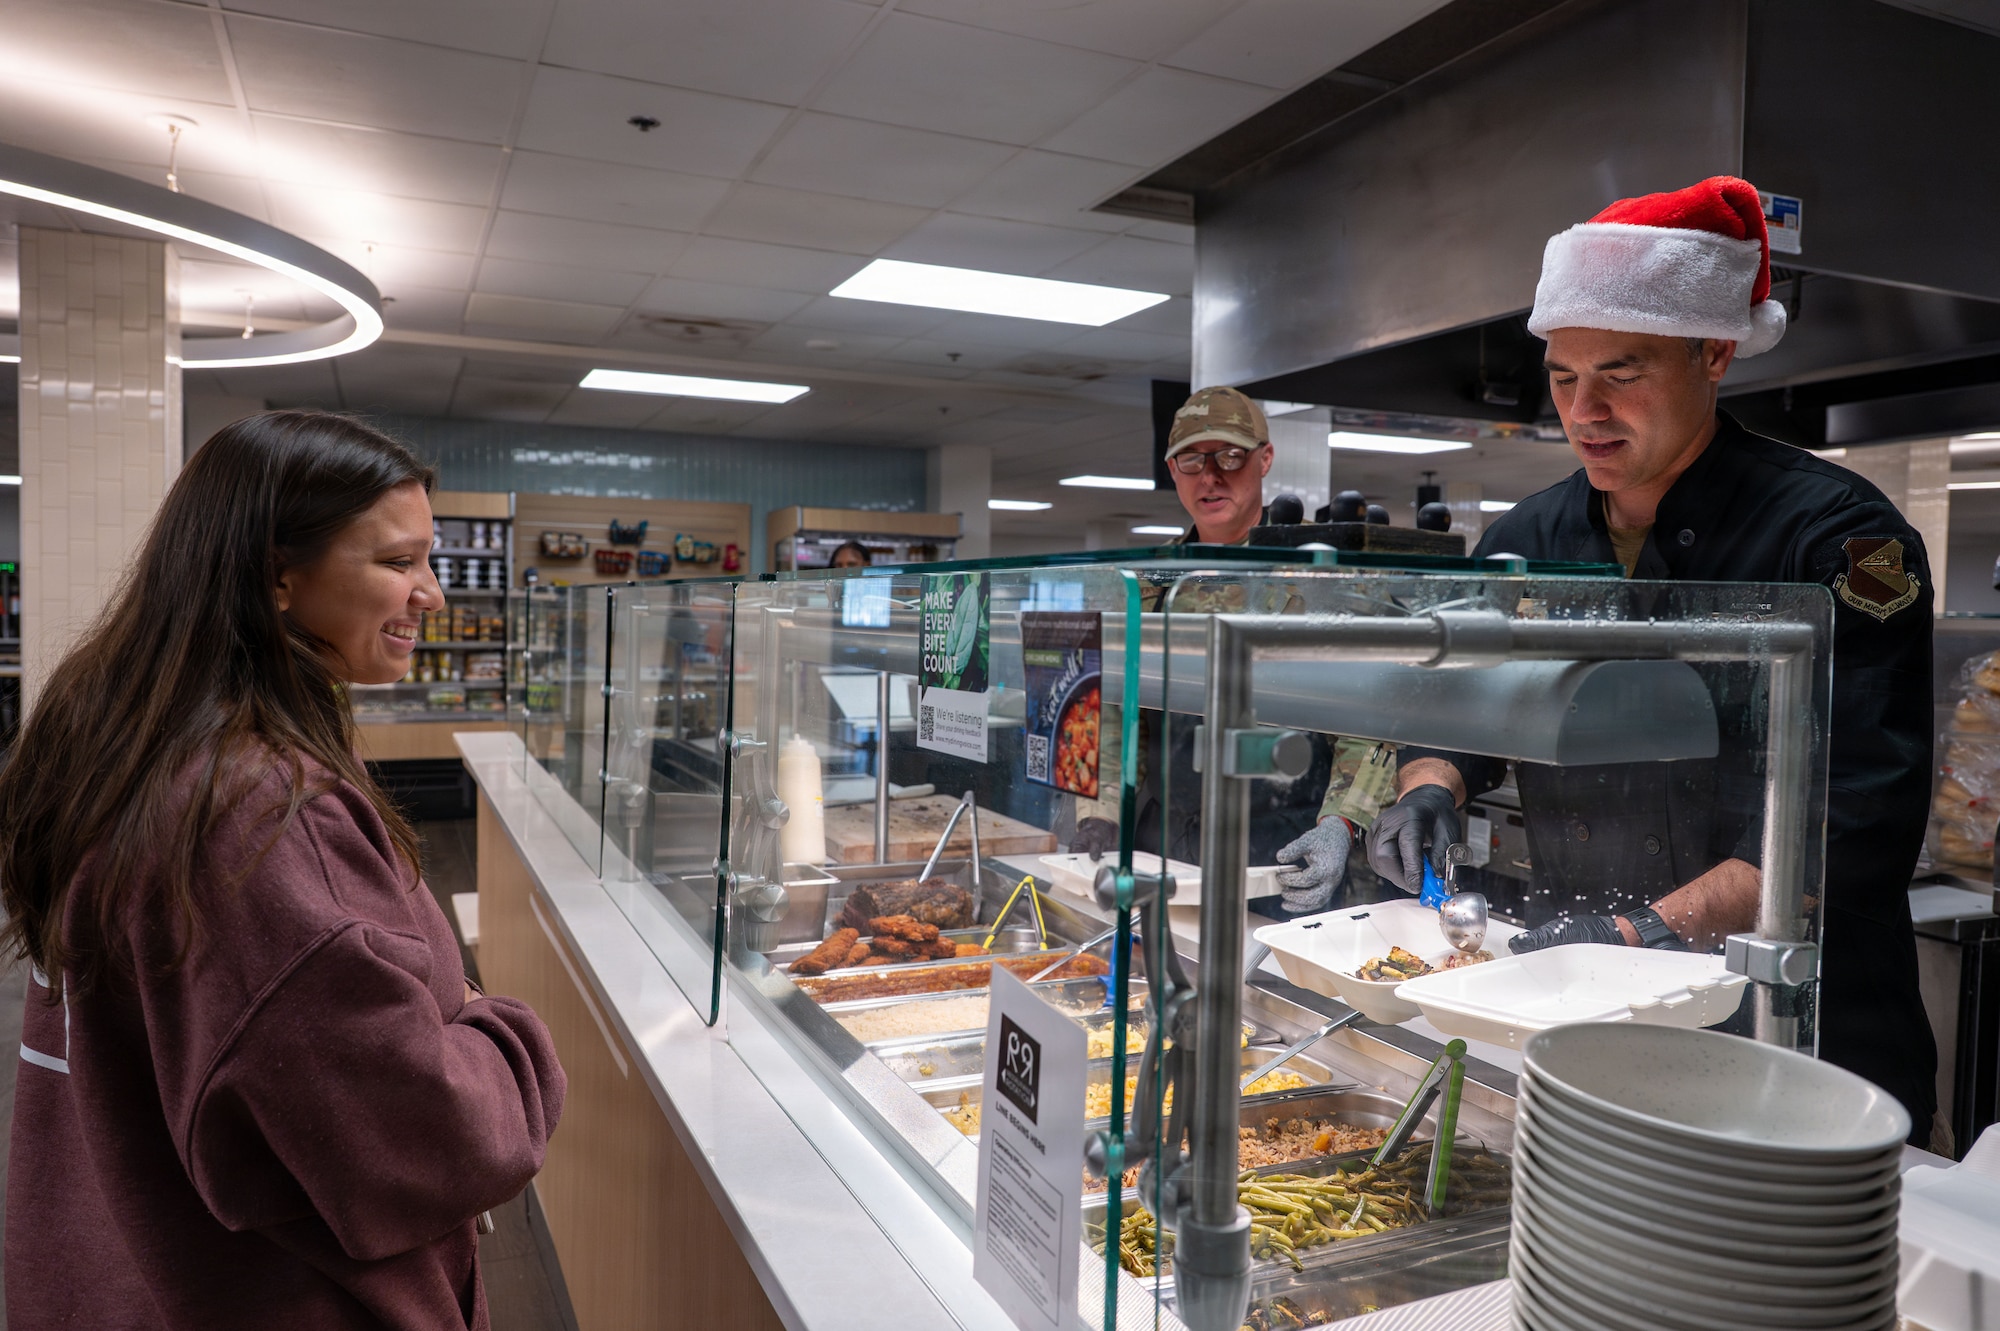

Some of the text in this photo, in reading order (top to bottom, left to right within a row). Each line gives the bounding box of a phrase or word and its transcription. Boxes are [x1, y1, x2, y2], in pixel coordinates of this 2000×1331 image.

[925, 592, 953, 610] MAKE
[1848, 595, 1913, 616] OUR MIGHT ALWAYS
[924, 613, 957, 631] EVERY
[924, 633, 946, 652] BITE
[923, 654, 959, 675] COUNT
[936, 707, 982, 729] We're listening
